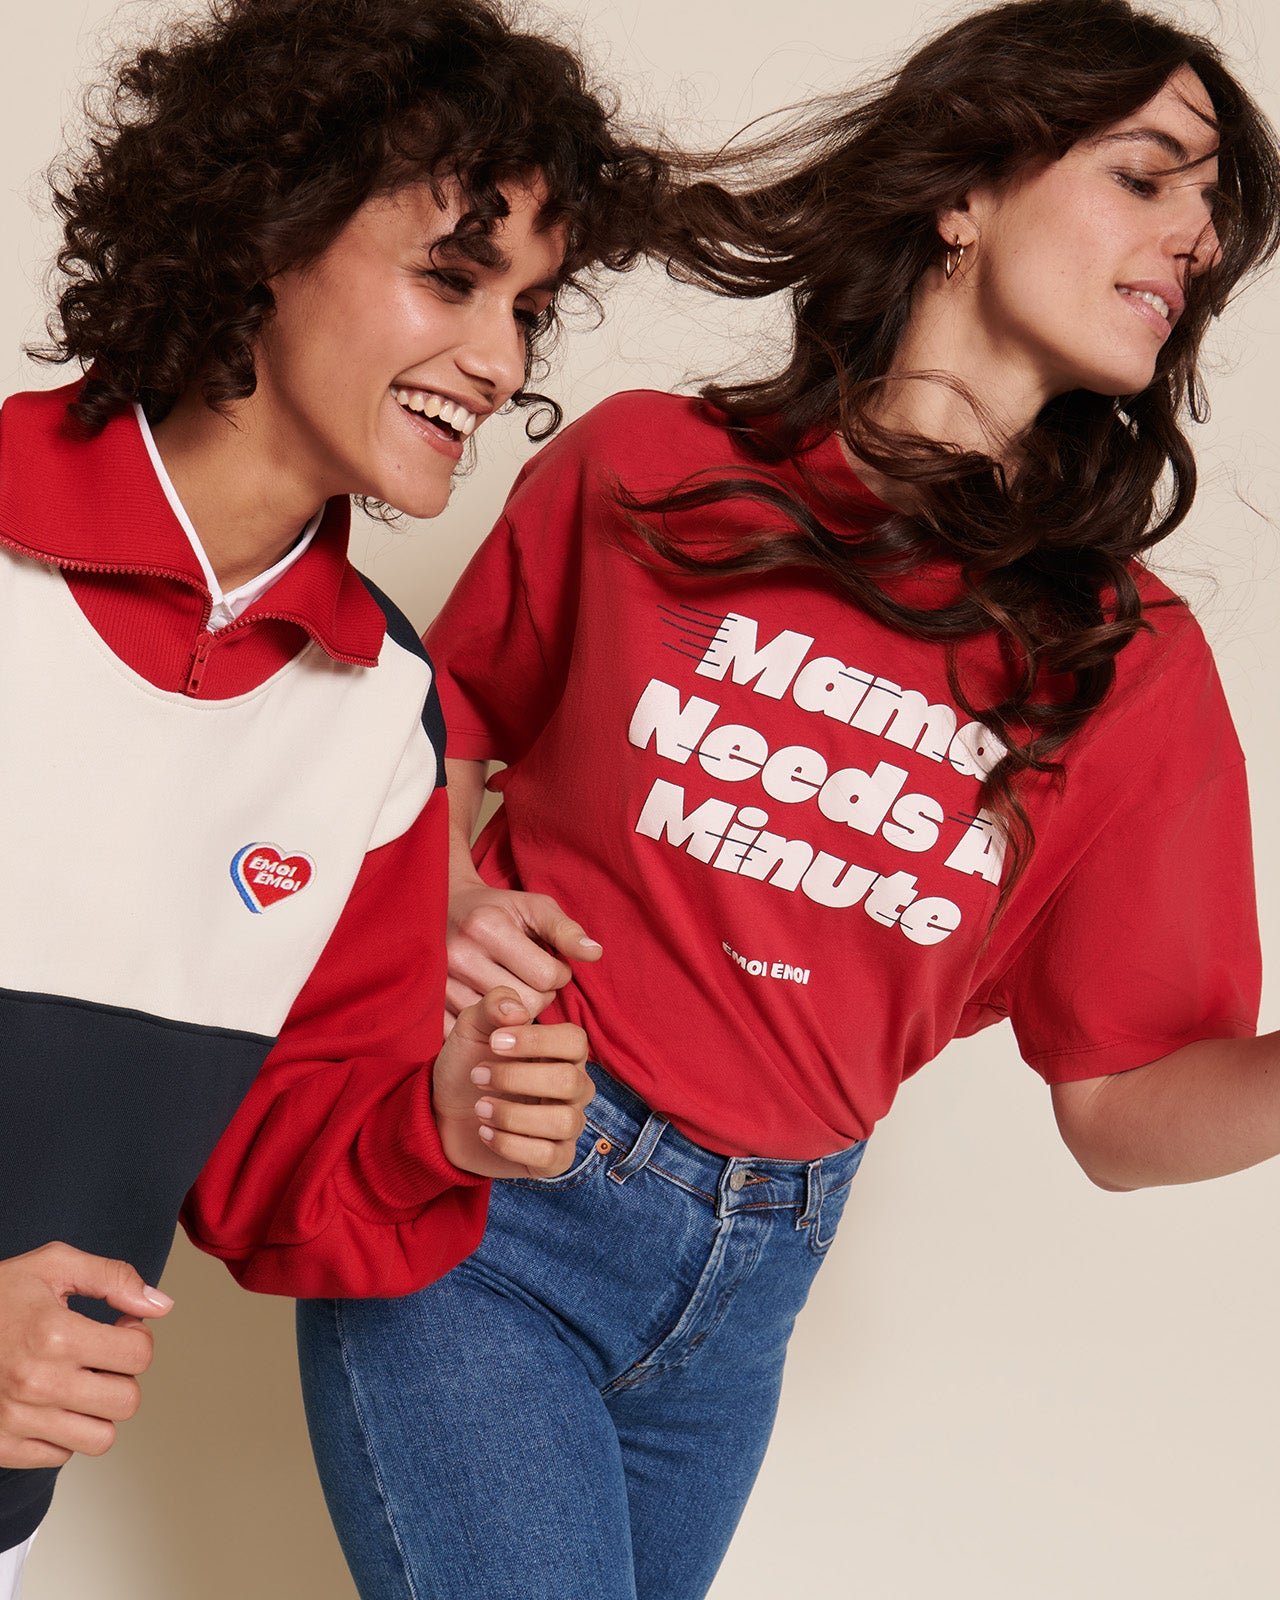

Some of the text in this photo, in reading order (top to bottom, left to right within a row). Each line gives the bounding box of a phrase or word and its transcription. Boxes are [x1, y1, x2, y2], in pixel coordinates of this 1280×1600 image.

[695, 612, 1008, 783] Mama
[248, 855, 297, 877] ÉMOI
[628, 679, 1008, 886] Needs A
[635, 778, 961, 946] Minute
